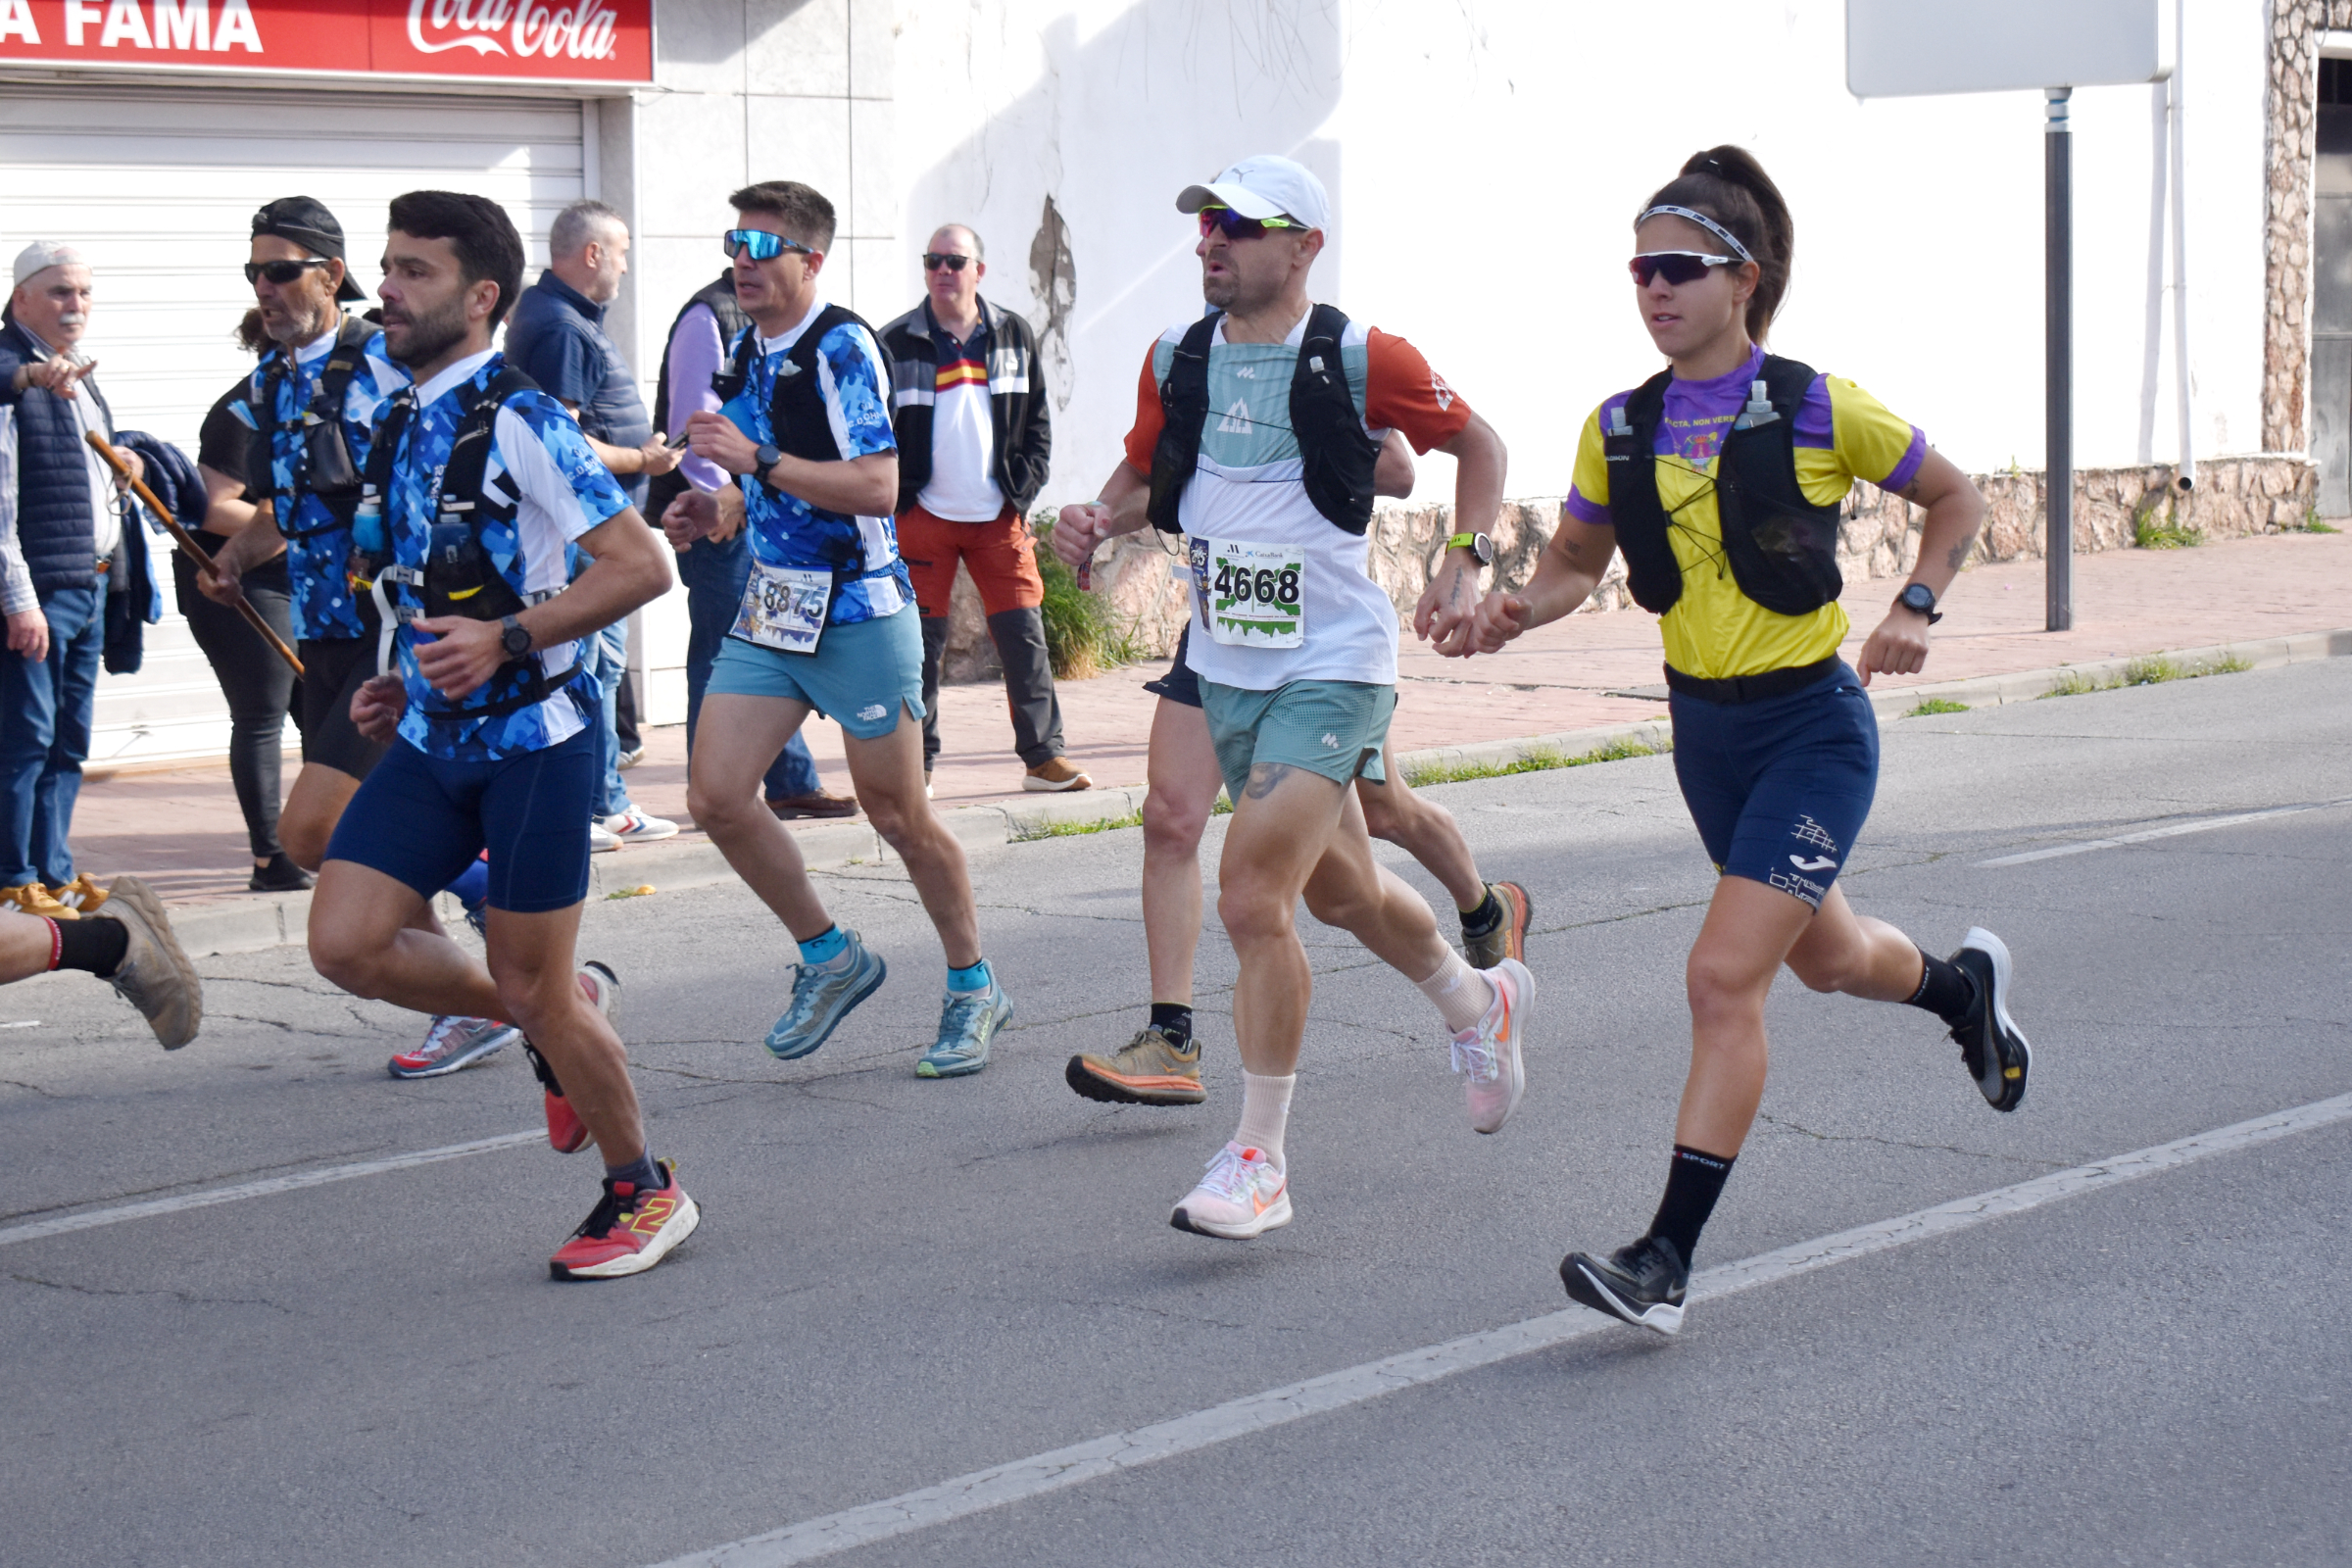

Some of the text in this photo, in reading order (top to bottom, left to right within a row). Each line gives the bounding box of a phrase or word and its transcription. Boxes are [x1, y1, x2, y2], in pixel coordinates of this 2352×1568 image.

[65, 0, 264, 53] FAMA
[1693, 415, 1710, 426] NON
[764, 583, 826, 618] 8875
[1214, 564, 1299, 605] 4668
[1682, 1152, 1726, 1169] SPORT
